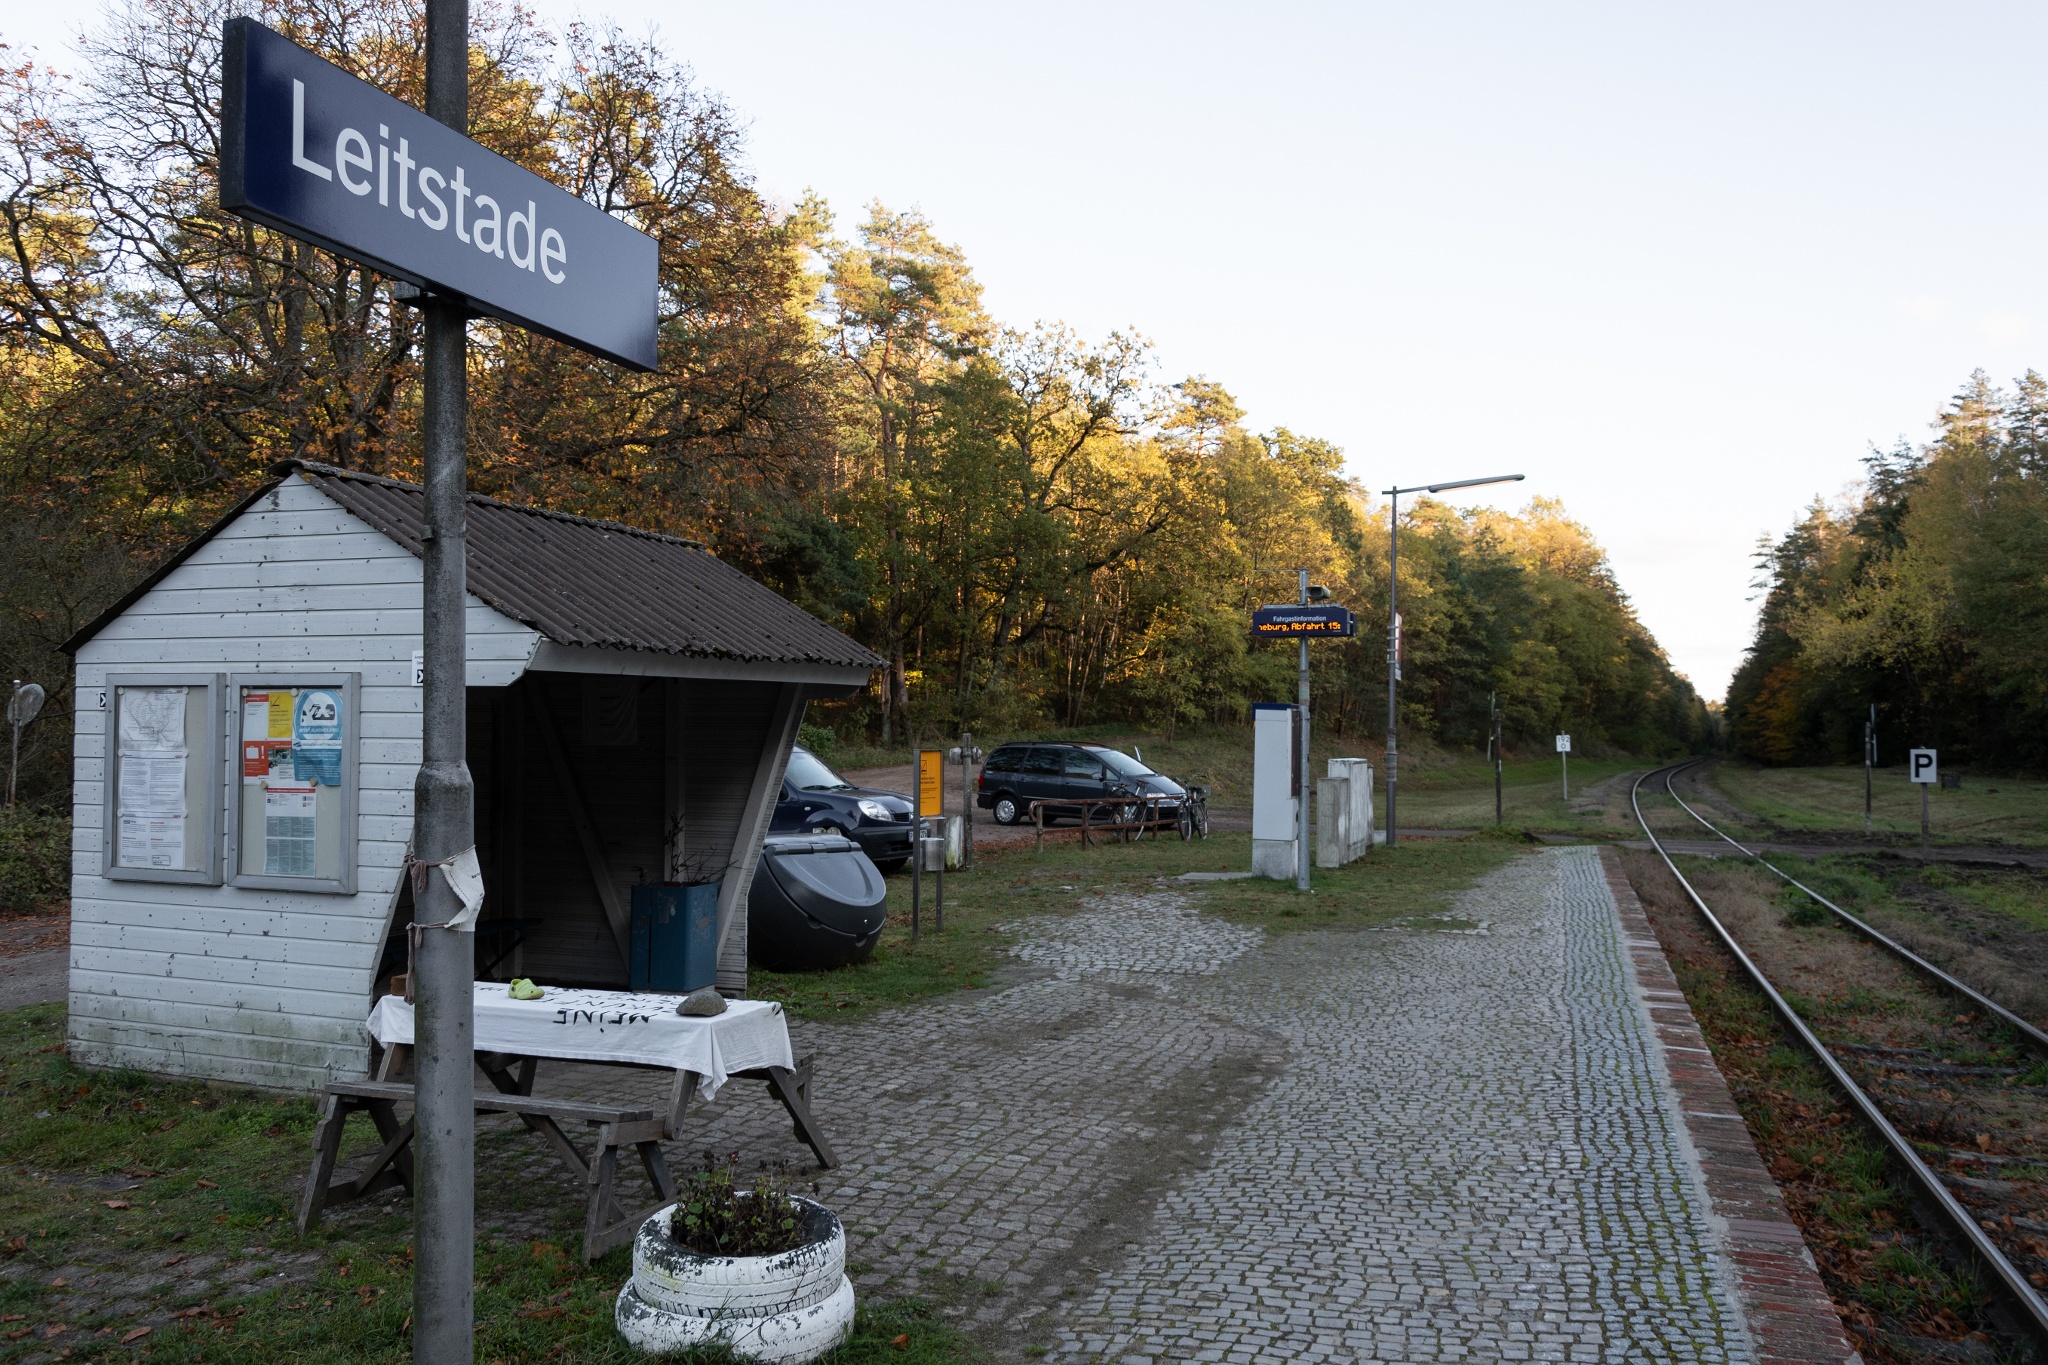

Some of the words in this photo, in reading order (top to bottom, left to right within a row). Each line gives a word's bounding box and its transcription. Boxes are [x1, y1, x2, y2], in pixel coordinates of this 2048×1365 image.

[292, 78, 567, 284] Leitstade
[1291, 622, 1326, 631] Abfahrt
[1558, 735, 1570, 743] 192
[1915, 754, 1933, 778] P
